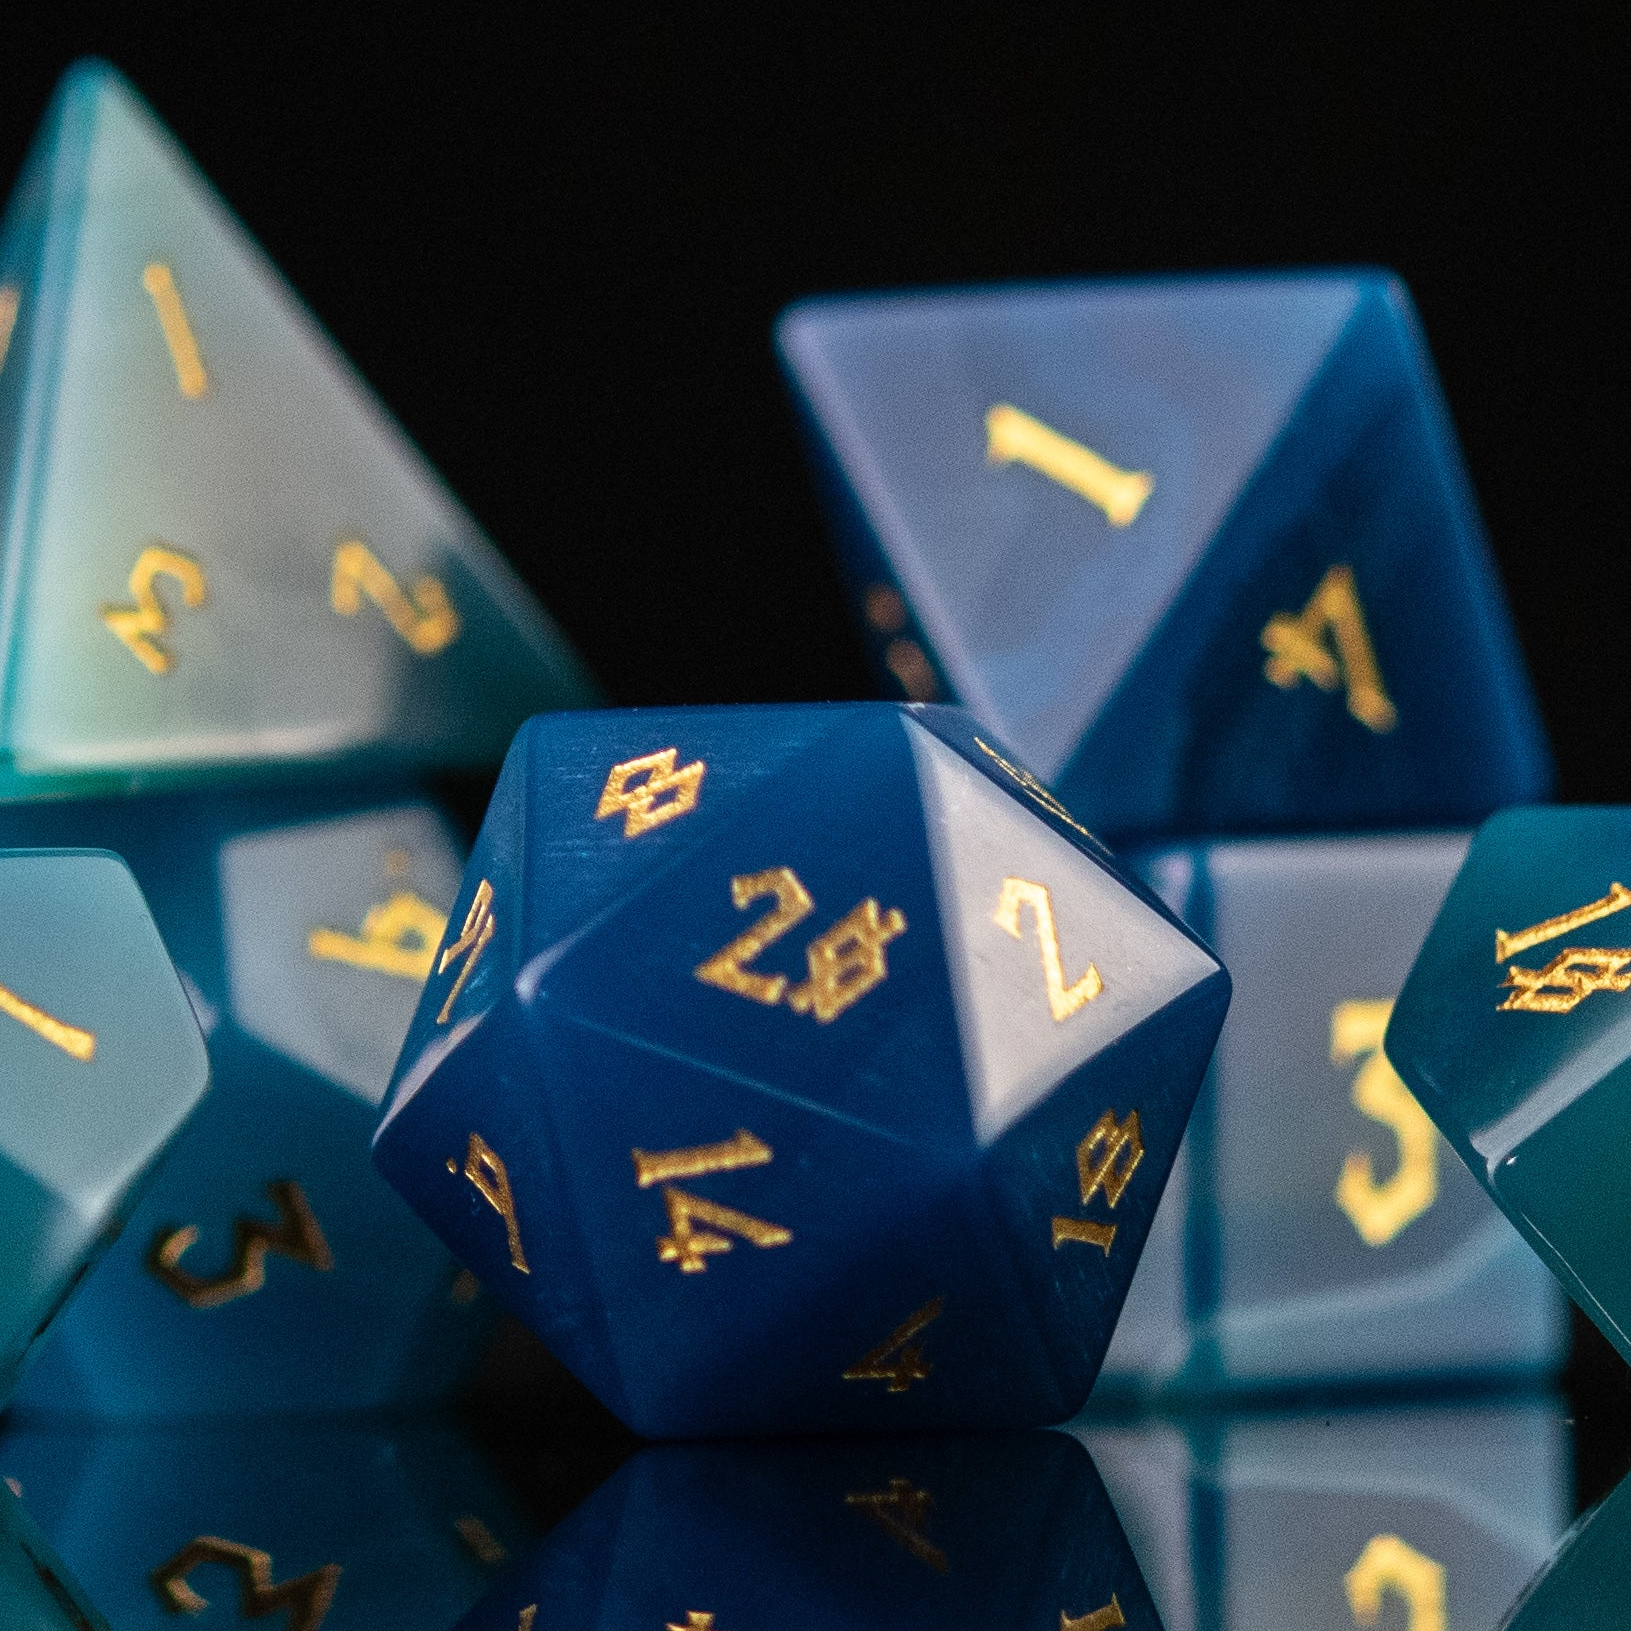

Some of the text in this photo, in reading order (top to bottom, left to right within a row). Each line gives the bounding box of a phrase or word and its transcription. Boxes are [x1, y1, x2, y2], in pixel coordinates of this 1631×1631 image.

[984, 405, 1154, 528] 1
[1261, 565, 1397, 733] 4
[594, 747, 704, 838] 8
[694, 866, 908, 1024] 20
[996, 876, 1104, 1022] 2
[150, 1180, 336, 1308] 3
[630, 1127, 793, 1274] 14
[1052, 1108, 1145, 1258] 18
[842, 1297, 944, 1392] 4
